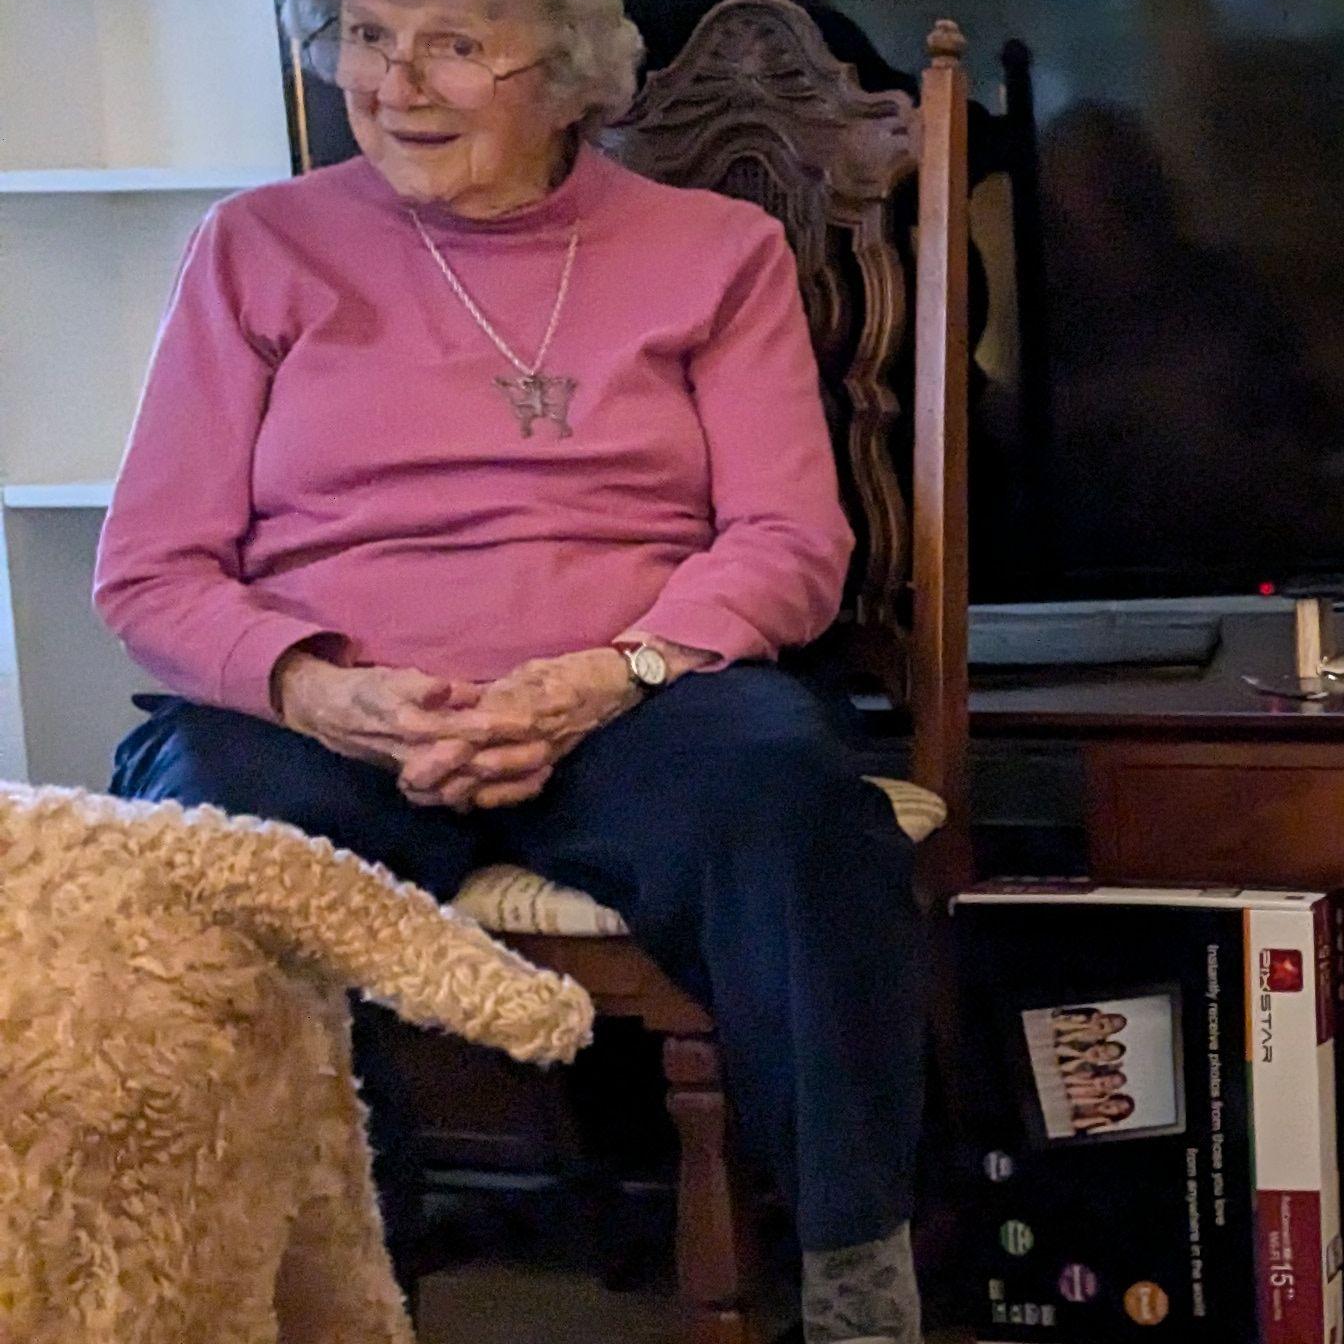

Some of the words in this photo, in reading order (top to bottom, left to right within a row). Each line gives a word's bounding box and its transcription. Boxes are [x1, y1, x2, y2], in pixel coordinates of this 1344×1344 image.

[1205, 943, 1221, 1001] Instantly
[1208, 1053, 1222, 1097] photos
[1211, 1099, 1224, 1131] from
